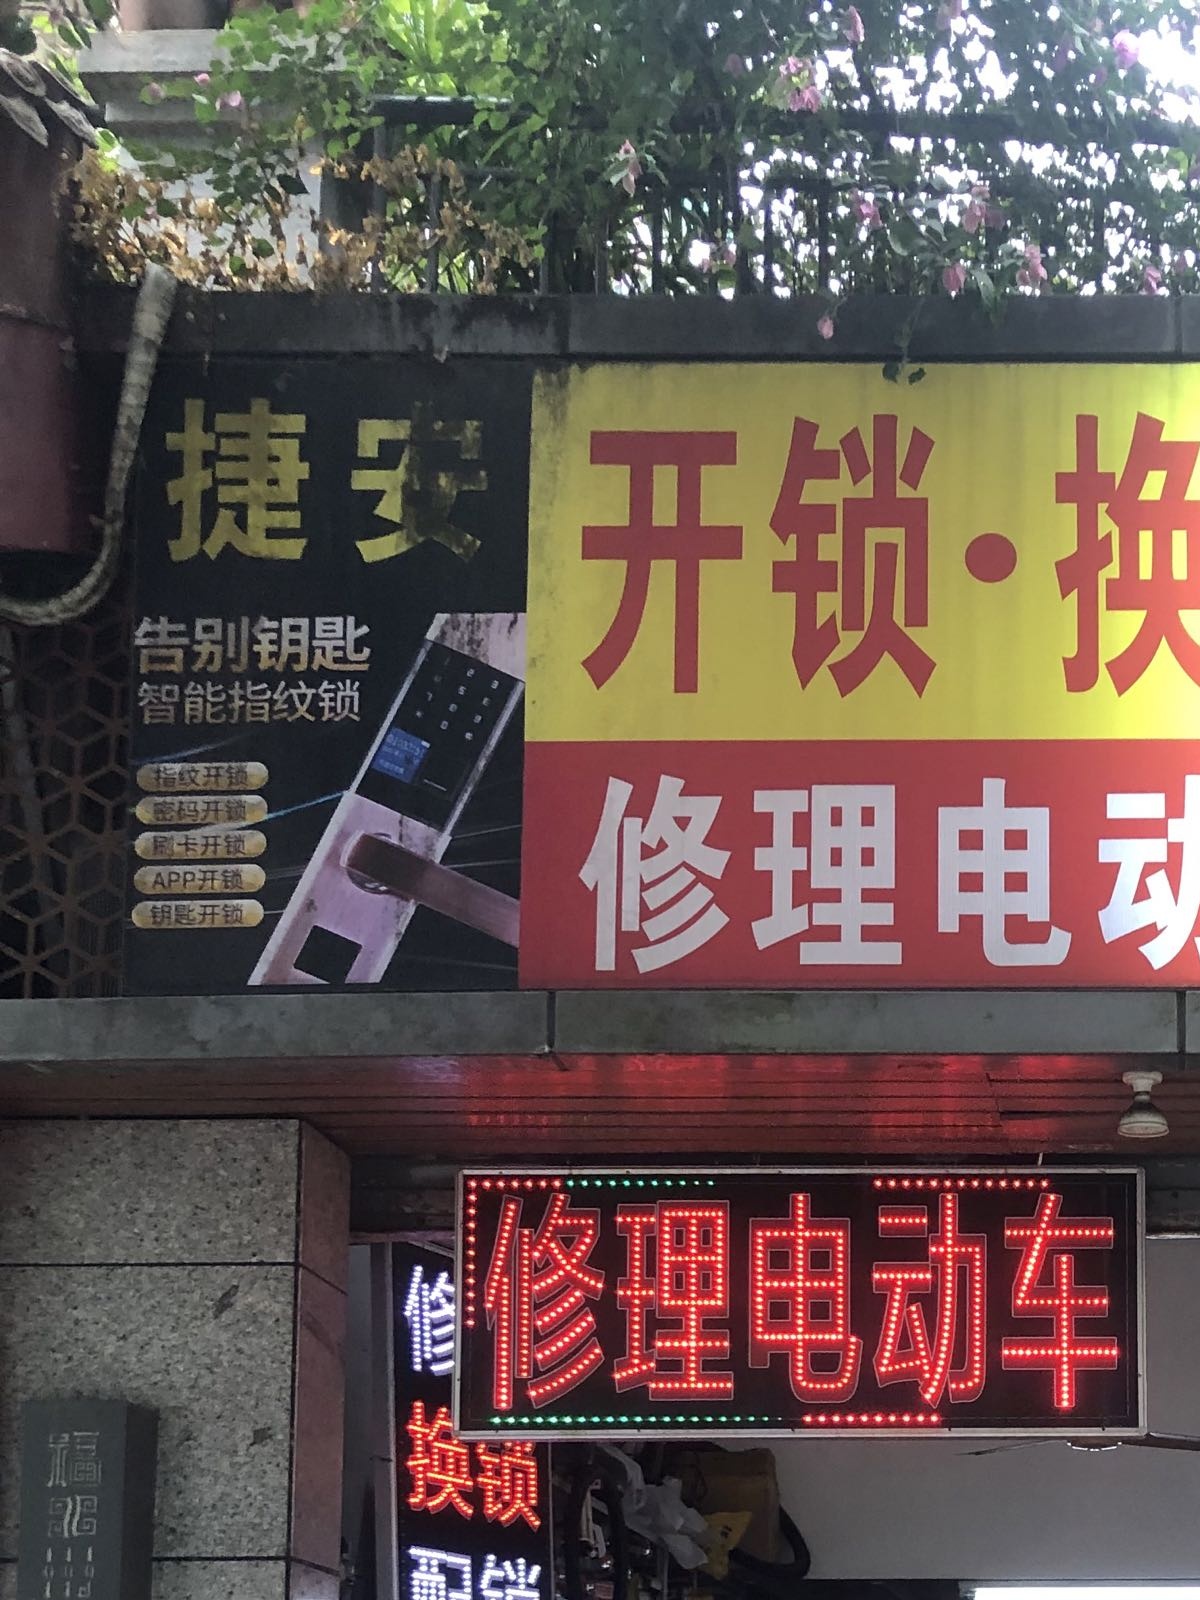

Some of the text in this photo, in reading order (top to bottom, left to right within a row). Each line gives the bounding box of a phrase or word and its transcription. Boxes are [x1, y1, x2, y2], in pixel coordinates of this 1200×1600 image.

[134, 615, 371, 676] 告别钥匙
[137, 680, 361, 725] 智能指纹锁
[154, 764, 248, 787] 指纹开锁
[153, 799, 246, 822] 密码开锁
[153, 834, 246, 857] 刷卡开锁
[152, 868, 244, 890] APP开锁
[151, 903, 243, 926] 钥匙开锁
[485, 1193, 1120, 1409] 修理电动车
[405, 1400, 543, 1530] 换锁
